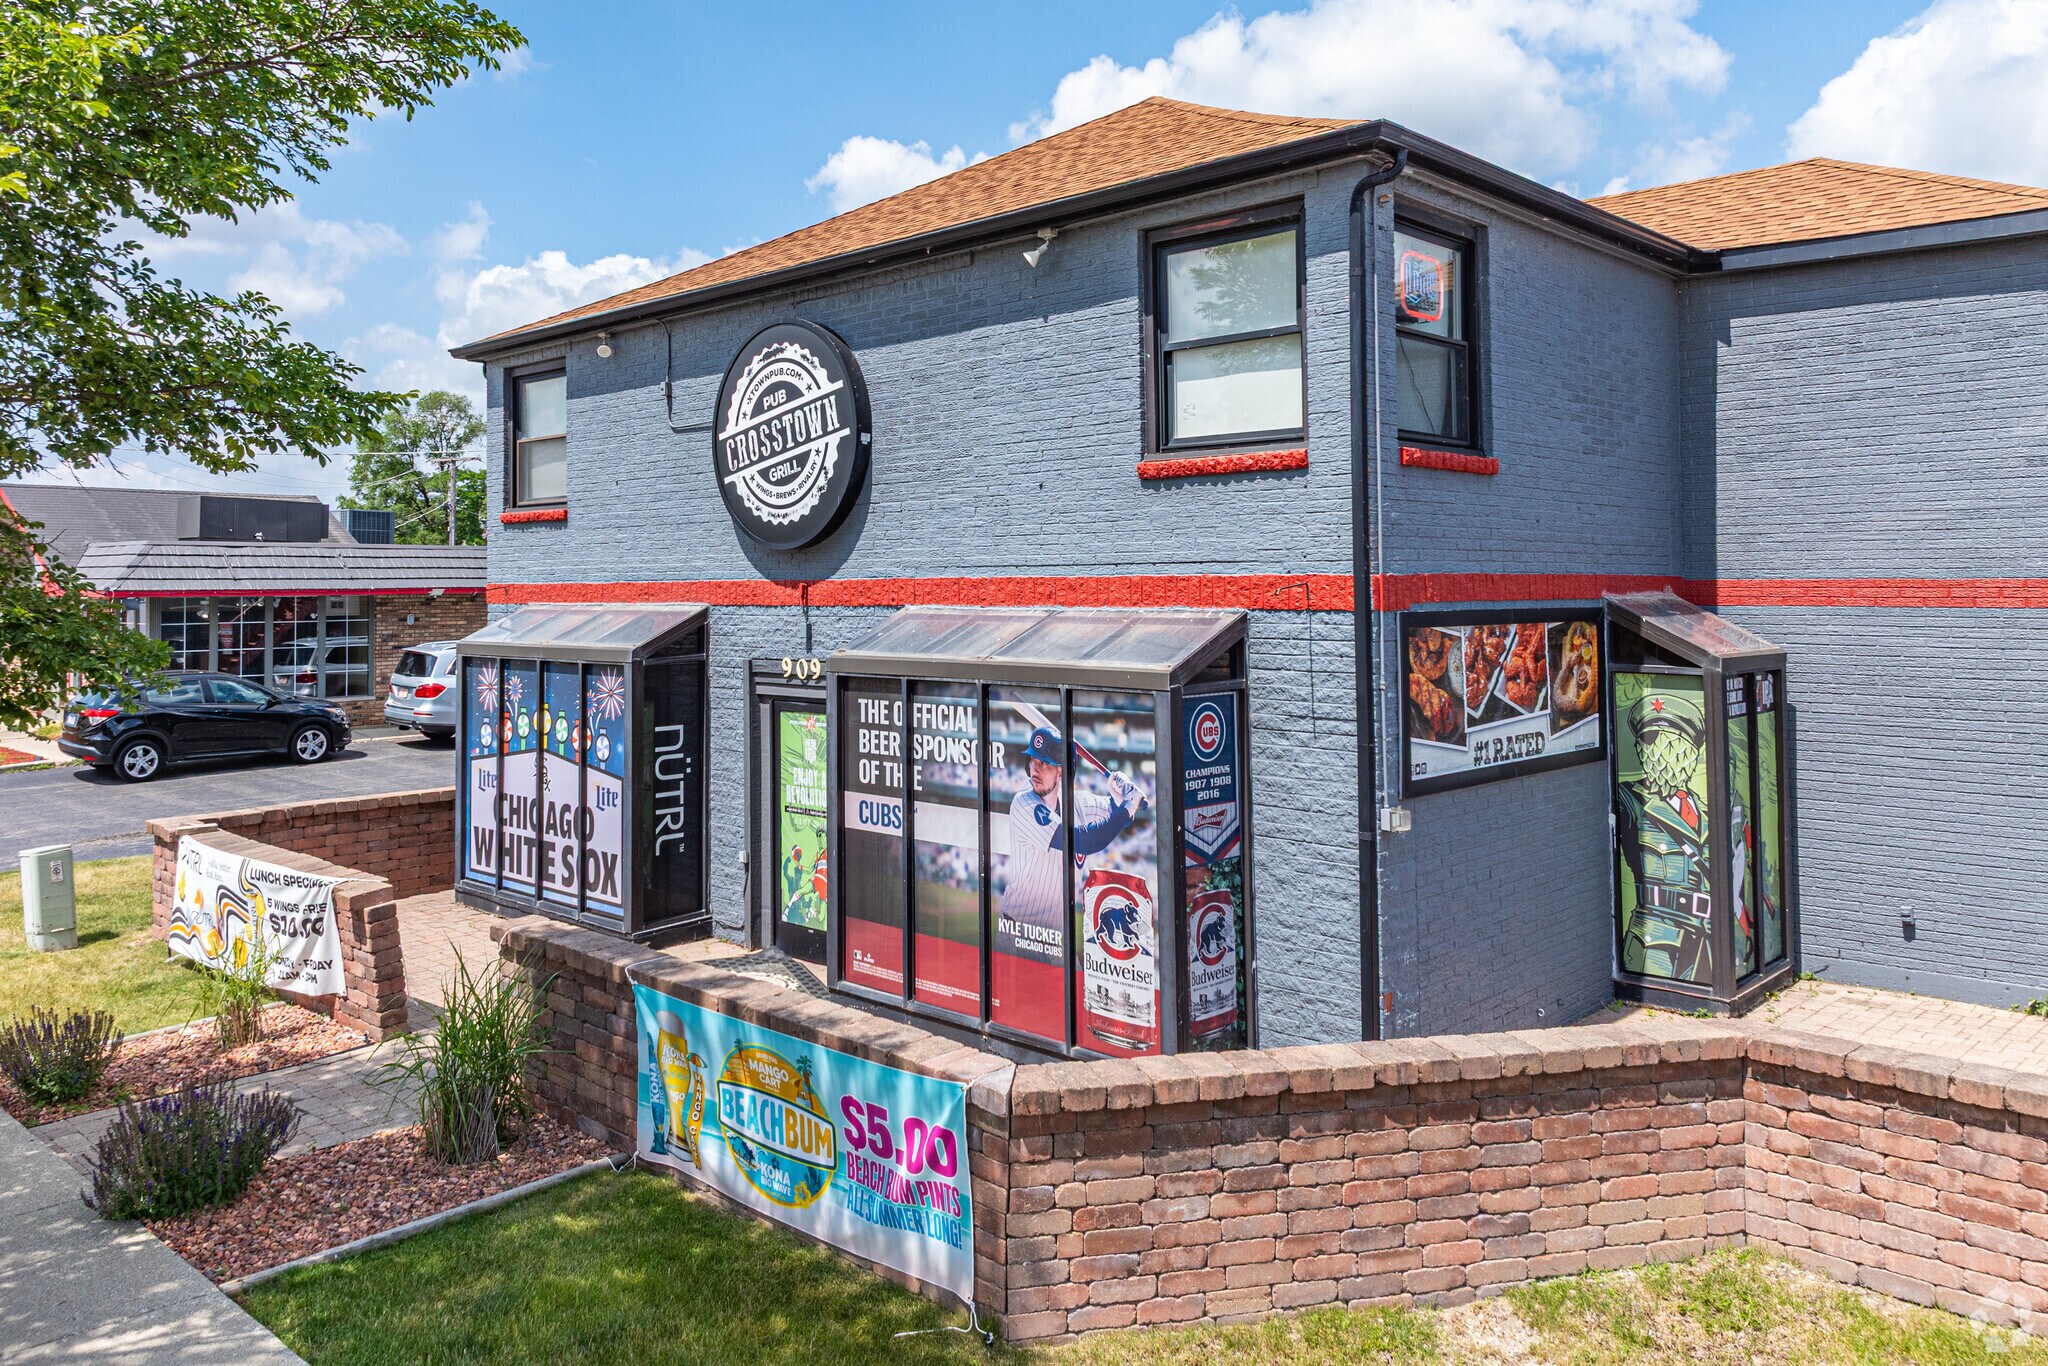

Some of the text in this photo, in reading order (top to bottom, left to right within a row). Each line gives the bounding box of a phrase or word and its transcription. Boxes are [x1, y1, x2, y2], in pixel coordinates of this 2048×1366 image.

[763, 389, 787, 410] PUB
[725, 394, 841, 472] CROSSTOWN
[755, 459, 817, 499] WINGS BREWS RIVALRY
[769, 459, 801, 482] GRILL
[781, 657, 821, 679] 909
[858, 698, 977, 734] THE OFFICIAL
[859, 728, 1005, 769] BEER SPONSOR
[478, 768, 497, 792] Lite
[859, 758, 923, 791] OF THE
[1185, 764, 1230, 779] CHAMPIONS
[1185, 775, 1231, 791] 1907 1908
[595, 785, 619, 812] Lite
[786, 784, 827, 808] REVOLUTIO
[1197, 788, 1220, 801] 2016
[493, 793, 595, 843] CHICAGO
[859, 800, 902, 830] CUBS
[474, 826, 618, 898] WHITE SOX
[250, 868, 281, 886] LUNCH
[267, 898, 272, 908] 5
[274, 899, 299, 915] WINGS
[998, 917, 1062, 946] KYLE TUCKER
[1014, 937, 1062, 957] CHICAGO CUBS
[1085, 952, 1153, 985] Budweiser
[1191, 964, 1234, 987] Budweiser
[663, 1045, 685, 1062] KONA
[650, 1062, 660, 1103] KONA
[749, 1058, 789, 1082] MANGO
[759, 1074, 781, 1088] CART
[692, 1074, 702, 1121] MANGO
[841, 1095, 957, 1178] $5.00
[760, 1161, 790, 1187] KONA
[760, 1175, 772, 1188] BIG
[772, 1180, 791, 1197] WAVE
[847, 1151, 961, 1218] BEACH BUM PINTS
[846, 1184, 962, 1250] ALL SUMMER LONG!
